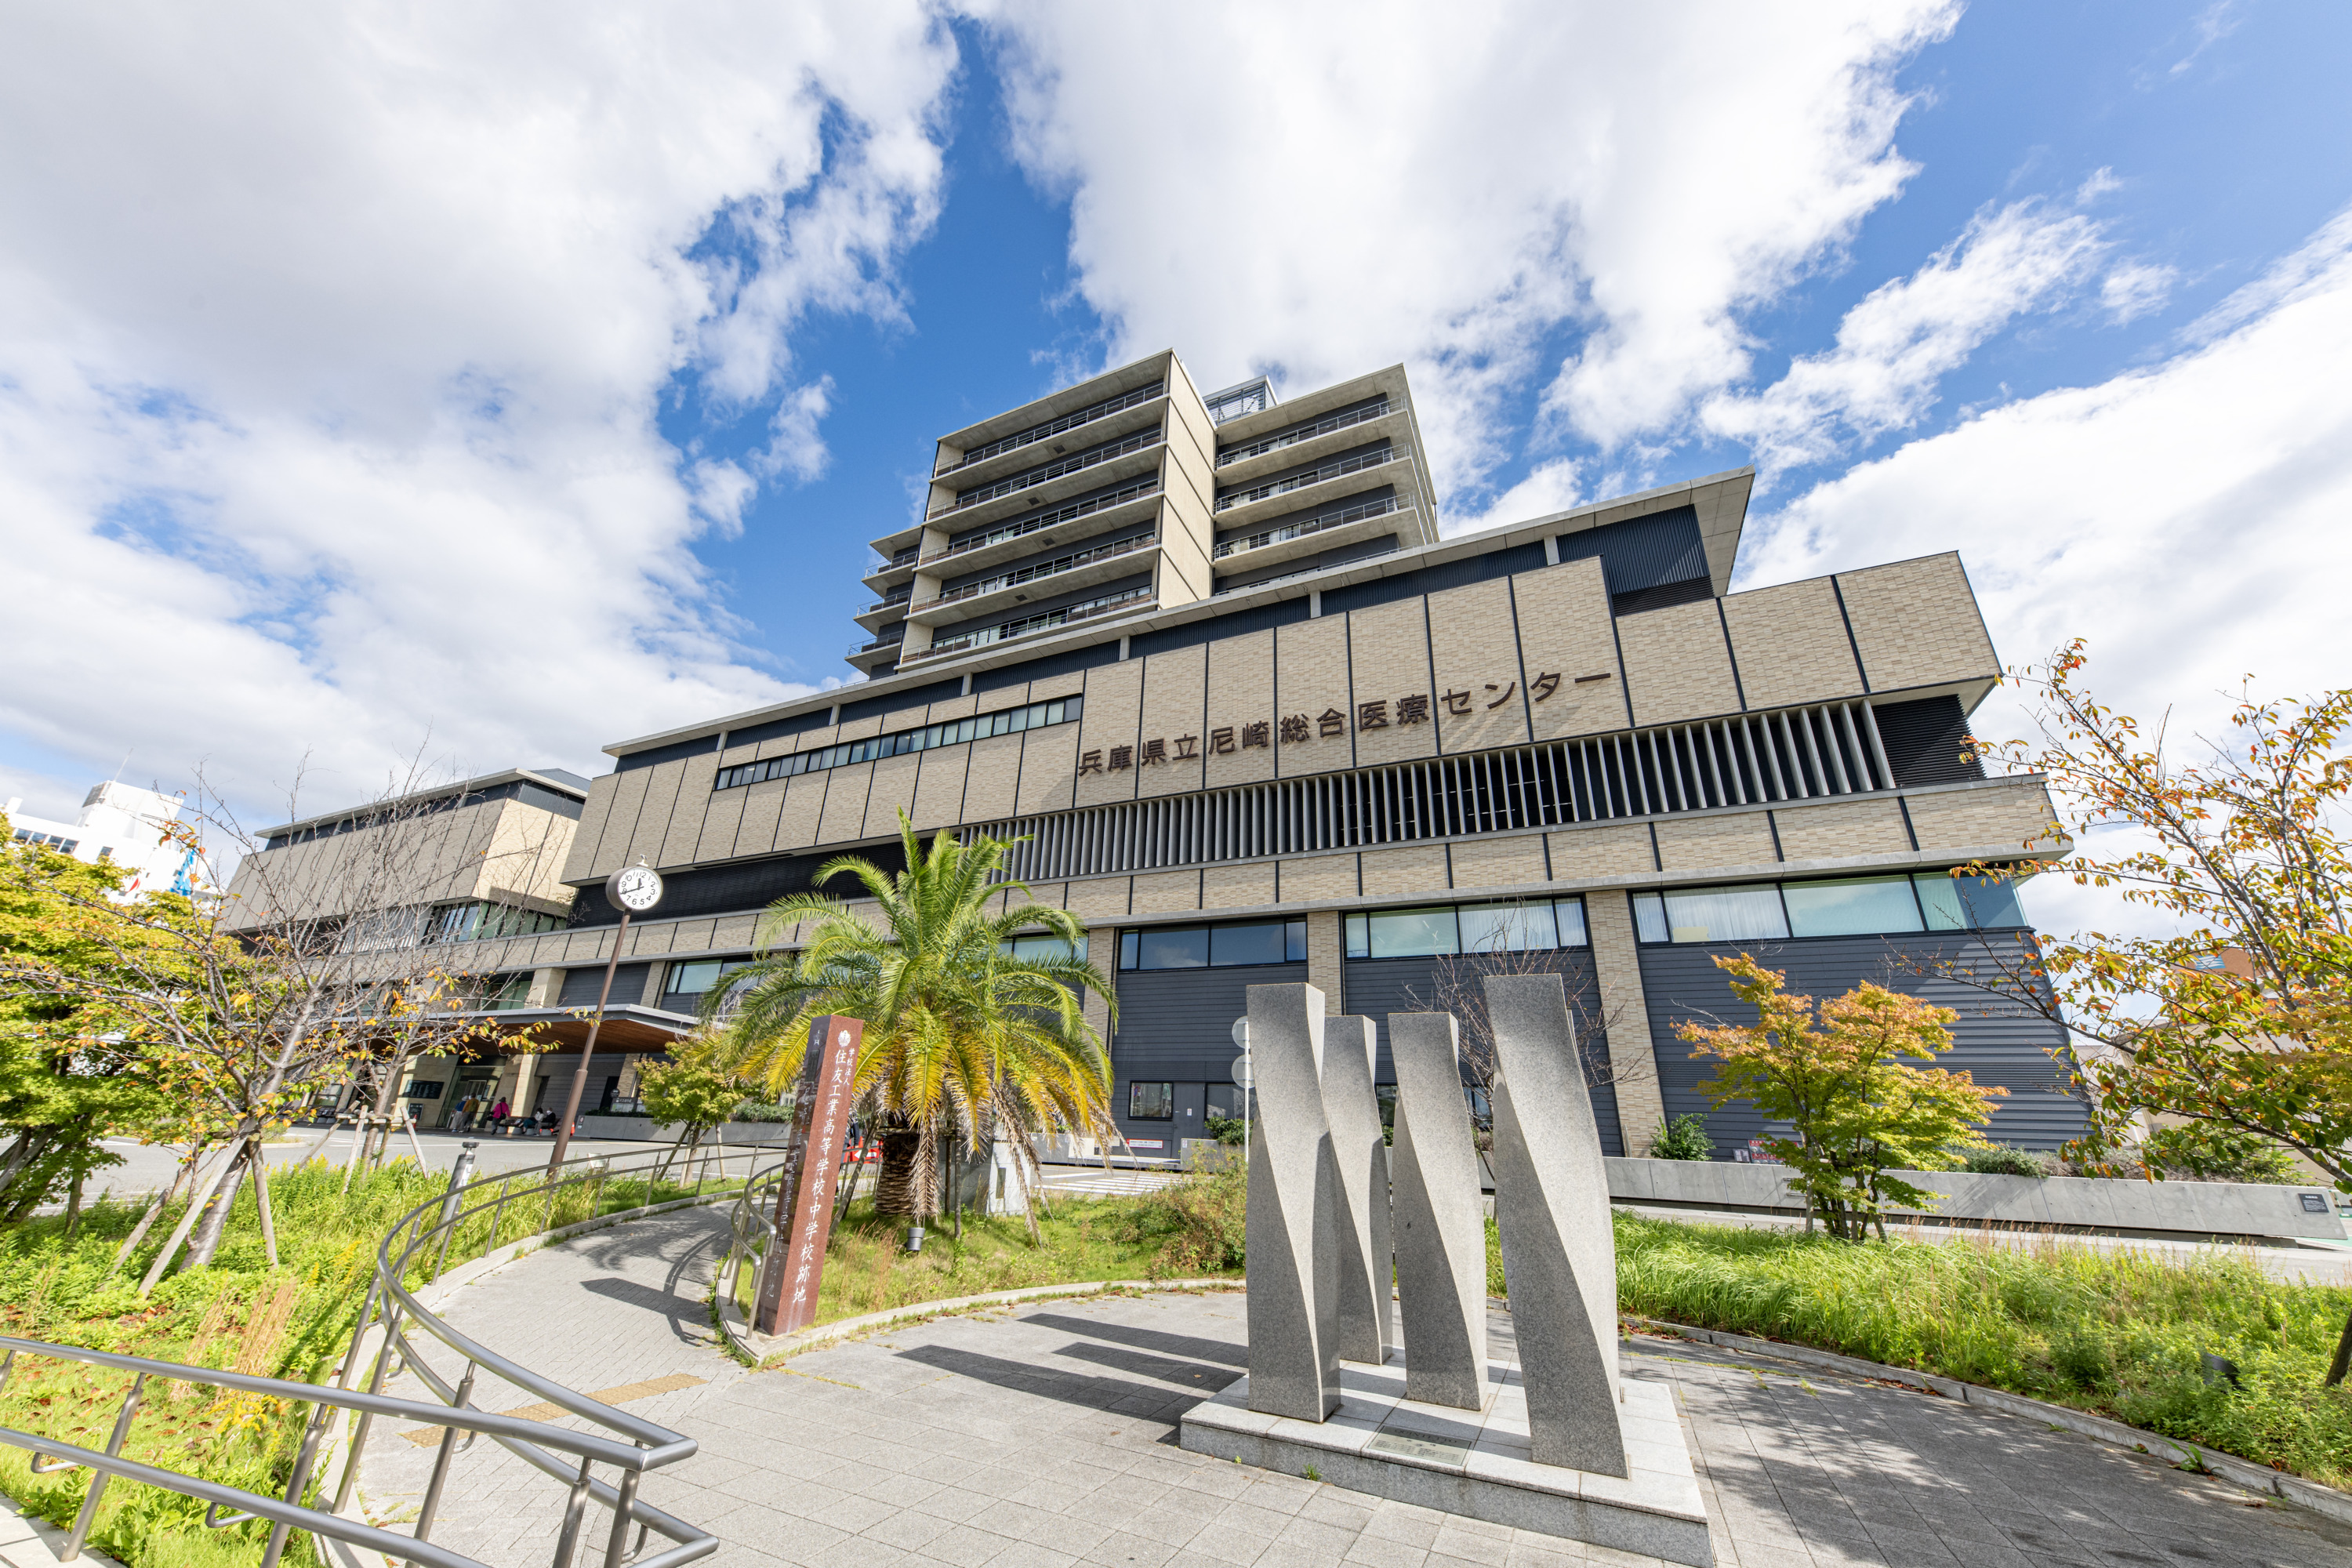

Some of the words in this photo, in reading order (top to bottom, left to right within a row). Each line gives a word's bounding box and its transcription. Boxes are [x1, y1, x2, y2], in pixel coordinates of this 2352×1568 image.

[1078, 671, 1612, 777] 兵庫県立尼崎総合医療センター
[843, 1047, 855, 1086] 学校法人
[793, 1049, 847, 1304] 住友工業高等学校・中学校跡地
